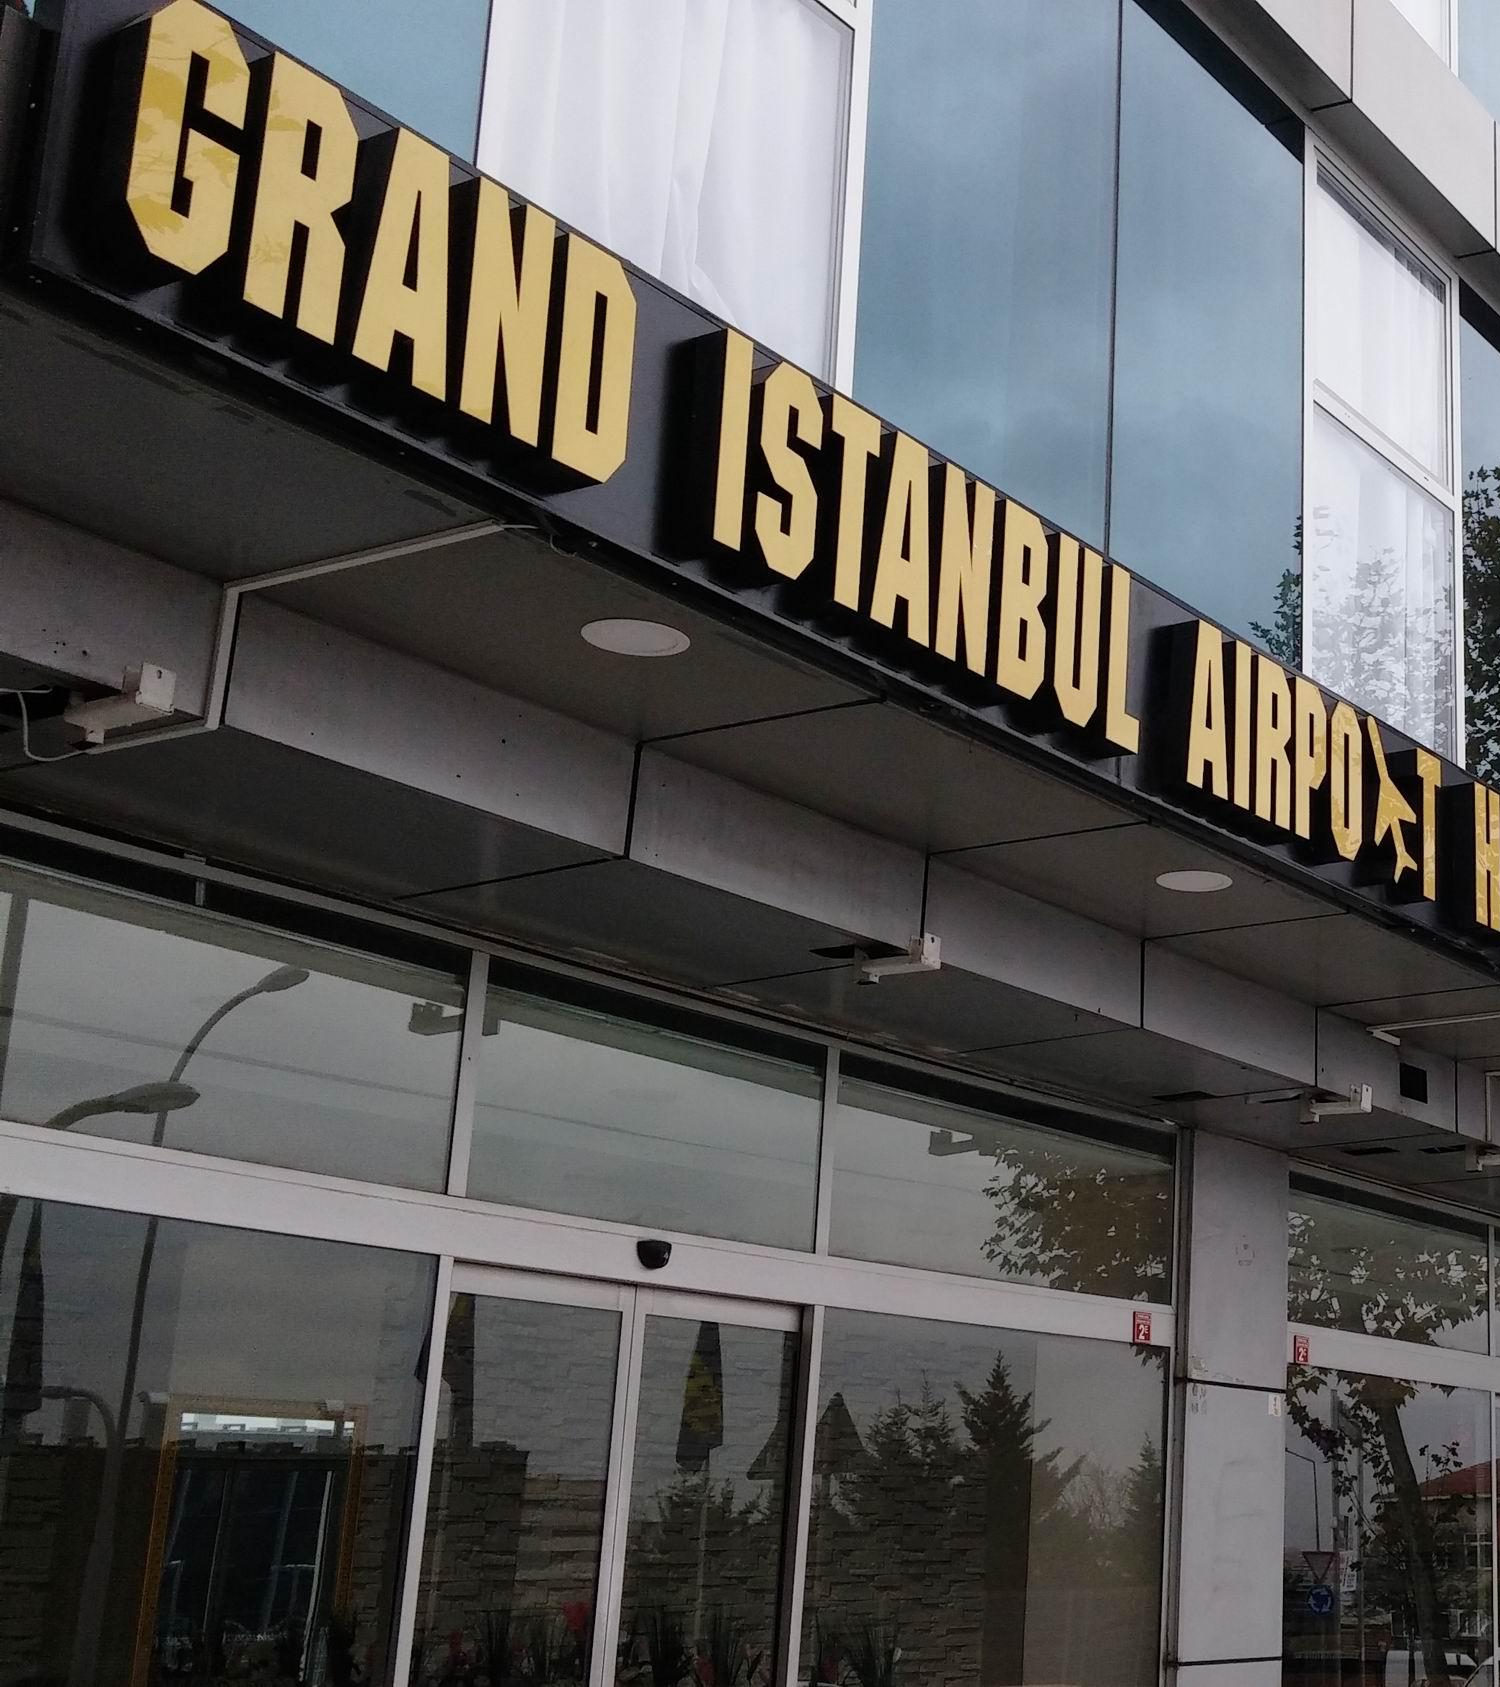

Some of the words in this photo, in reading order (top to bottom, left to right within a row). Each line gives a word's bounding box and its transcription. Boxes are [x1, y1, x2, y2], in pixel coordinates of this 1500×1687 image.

[126, 0, 637, 484] GRAND
[712, 328, 1140, 755] ISTANBUL
[1186, 618, 1442, 902] AIRPOT
